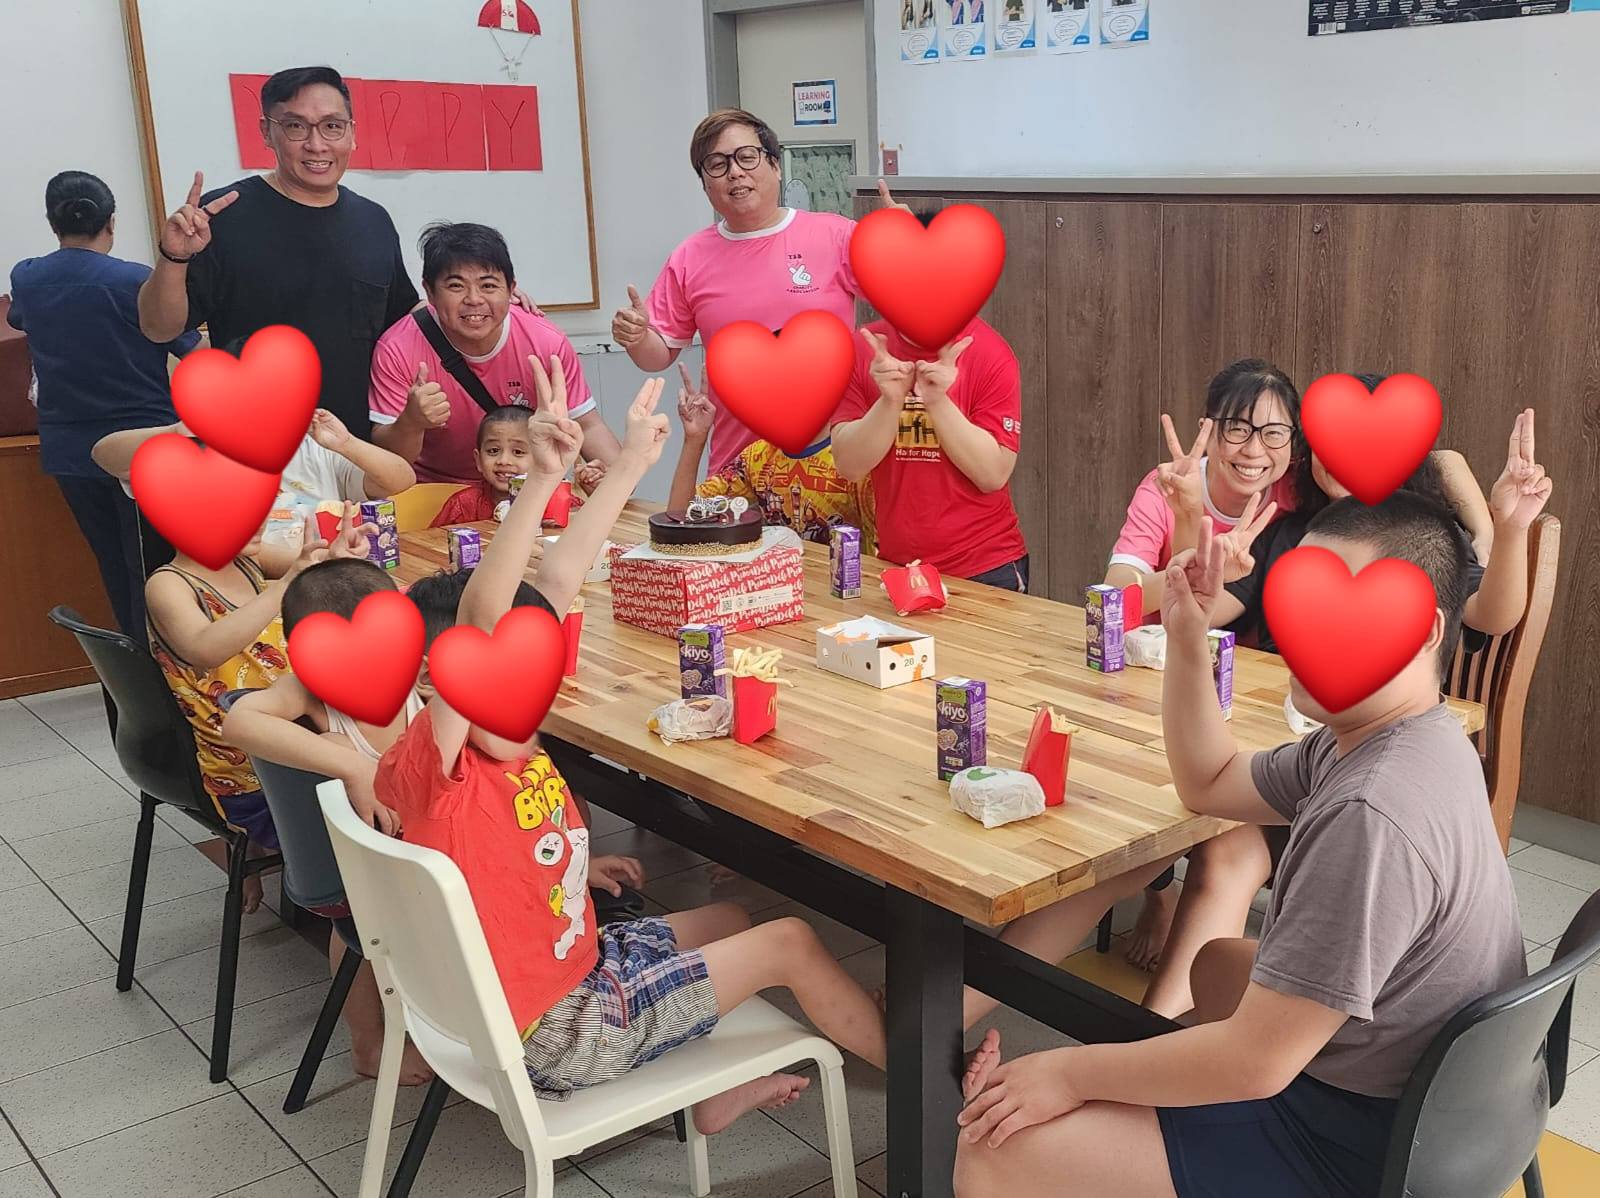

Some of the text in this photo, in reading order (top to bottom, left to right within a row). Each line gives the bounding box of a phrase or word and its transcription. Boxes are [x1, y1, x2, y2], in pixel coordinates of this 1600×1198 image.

[798, 91, 831, 101] LEARNING
[805, 103, 824, 112] ROOM
[909, 449, 920, 457] for
[921, 450, 941, 459] Hope
[684, 646, 709, 660] kiyo
[904, 658, 915, 667] 20
[941, 702, 966, 720] kiyo
